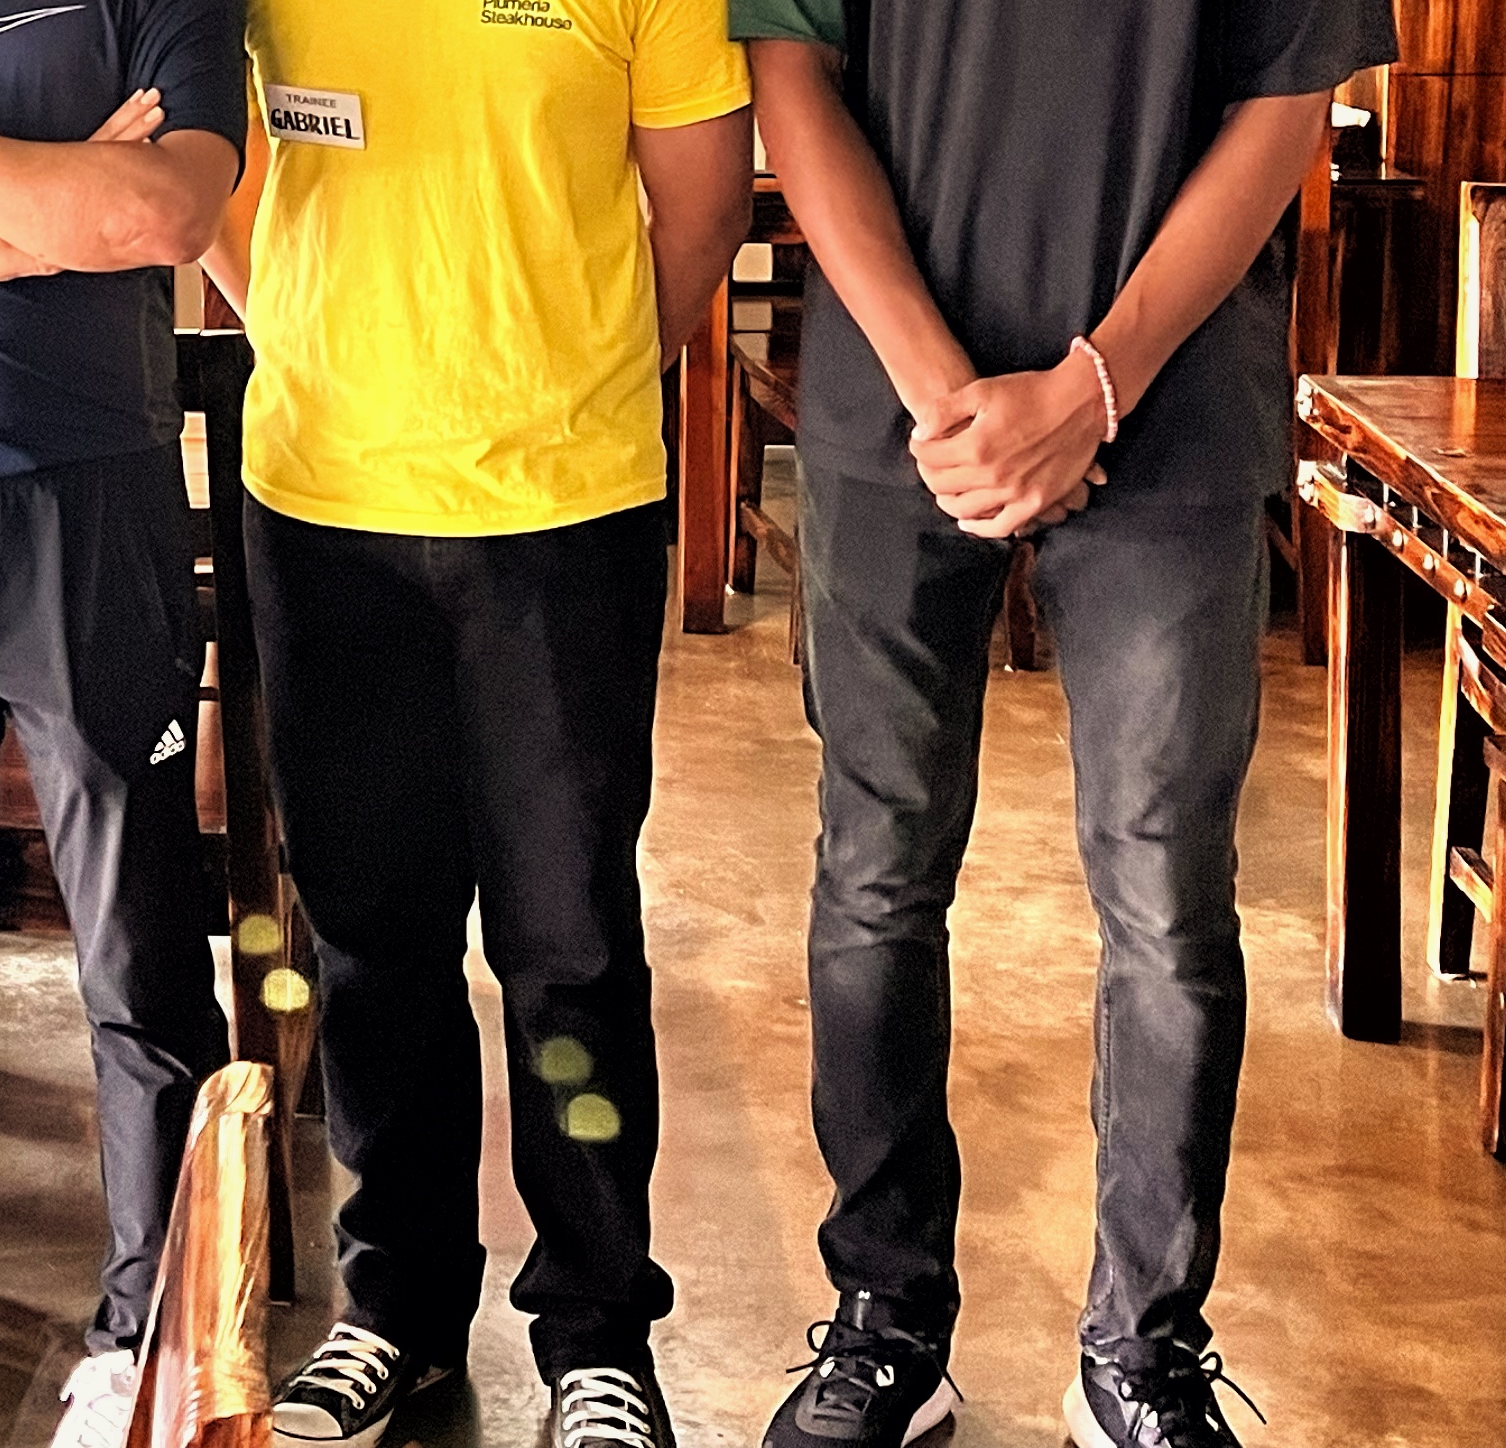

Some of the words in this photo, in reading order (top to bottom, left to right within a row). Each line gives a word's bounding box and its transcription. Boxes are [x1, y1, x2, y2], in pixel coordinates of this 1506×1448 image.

[480, 10, 573, 31] Steakhouse
[285, 93, 338, 109] TRAINEE
[270, 108, 361, 140] GABRIEL
